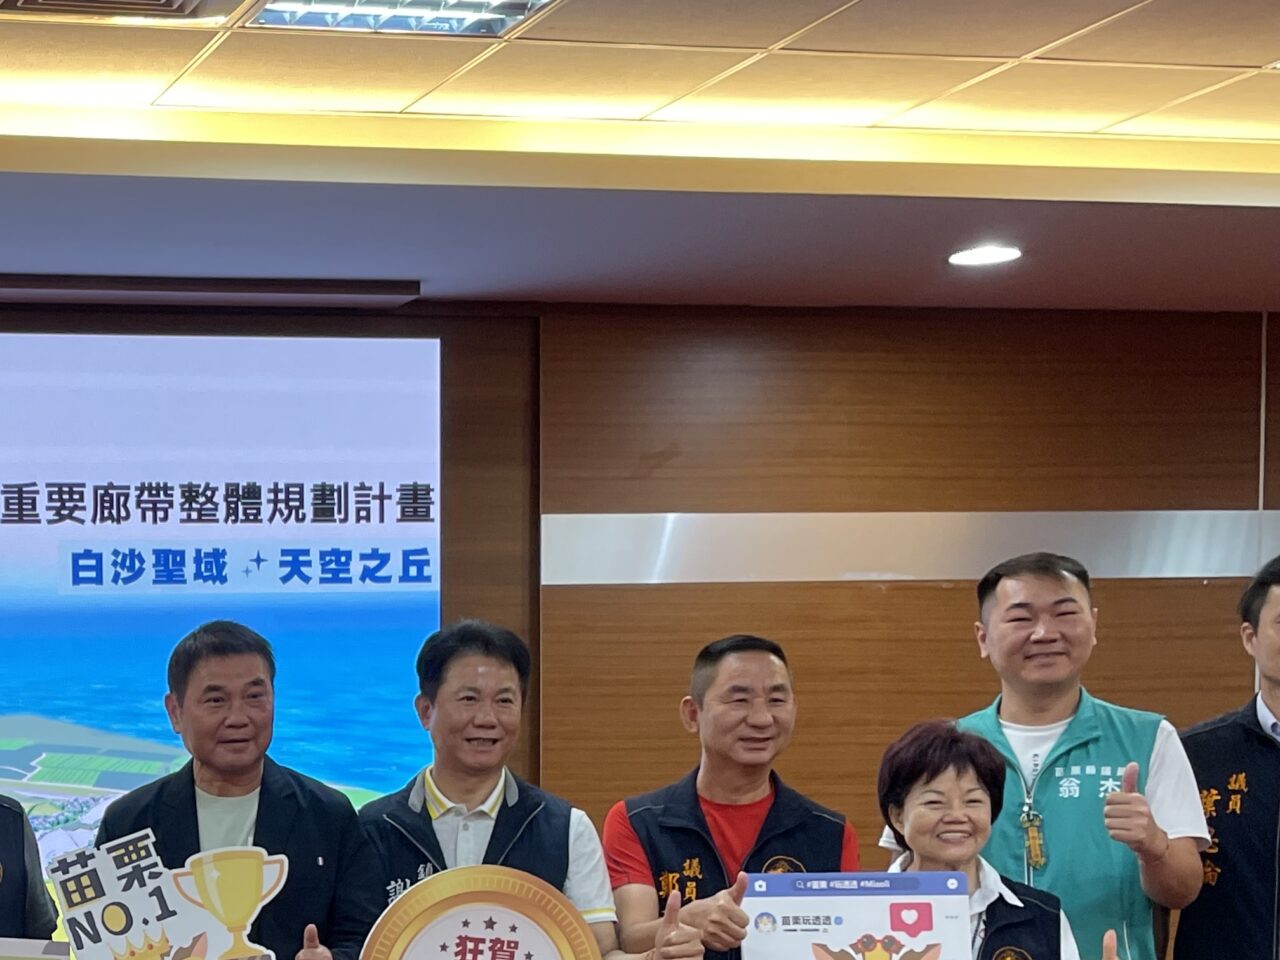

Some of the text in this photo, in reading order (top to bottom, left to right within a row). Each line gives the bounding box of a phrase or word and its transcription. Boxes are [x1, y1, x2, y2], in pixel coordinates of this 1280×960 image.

[70, 548, 433, 586] 白沙聖域 天空之丘
[51, 833, 163, 908] 苗栗
[66, 885, 178, 951] NO.1
